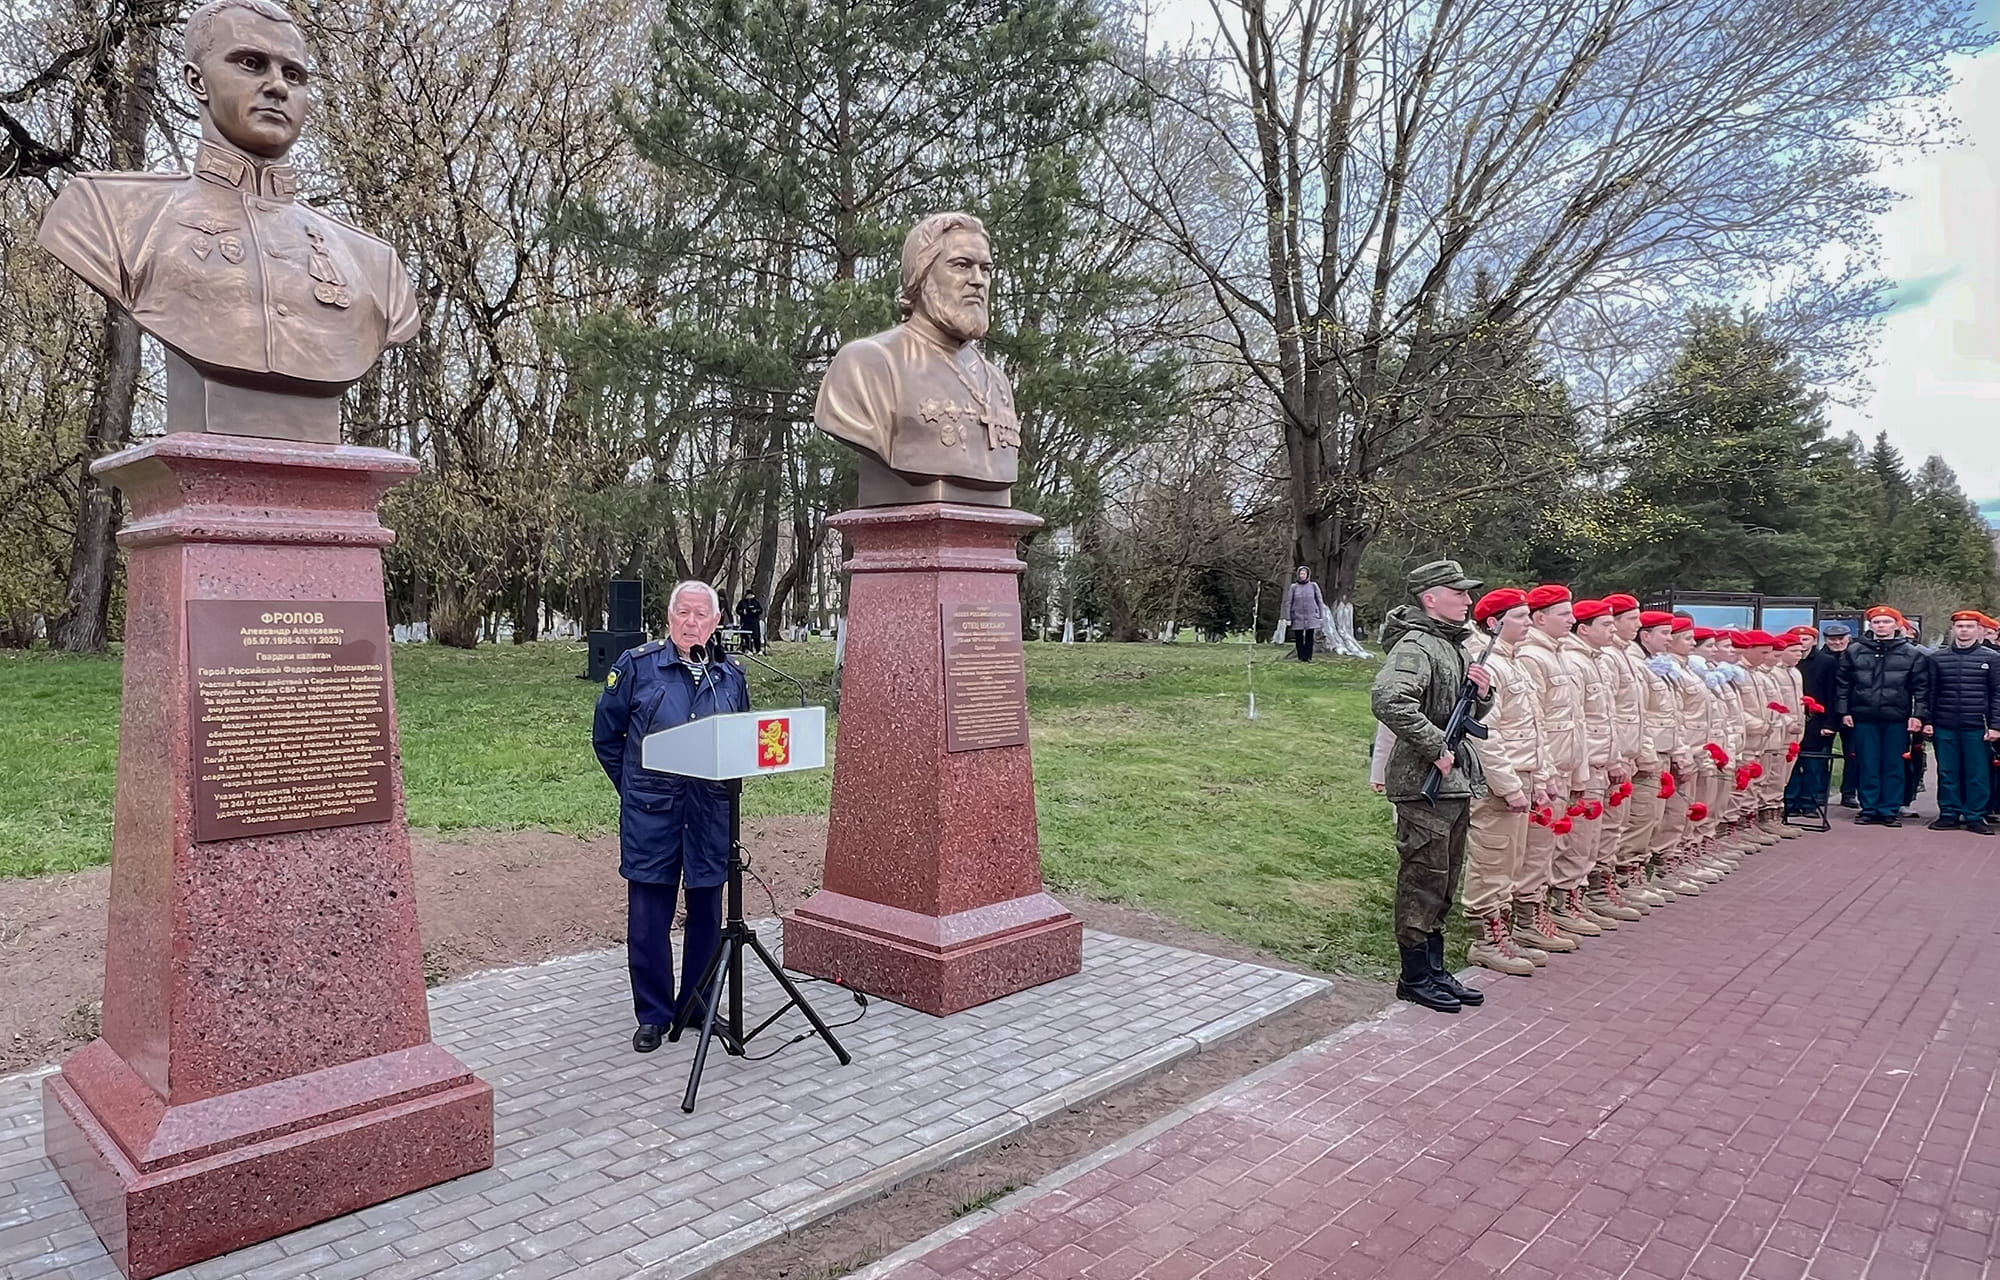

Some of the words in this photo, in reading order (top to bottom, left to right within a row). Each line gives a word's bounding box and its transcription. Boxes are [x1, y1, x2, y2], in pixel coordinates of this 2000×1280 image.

[261, 612, 324, 624] ФРОЛОВ
[198, 667, 226, 677] Герой
[228, 666, 281, 675] Российской
[333, 664, 383, 672] (посмертно)
[245, 788, 290, 798] Президента
[292, 783, 336, 793] Российской
[305, 792, 344, 800] Александр
